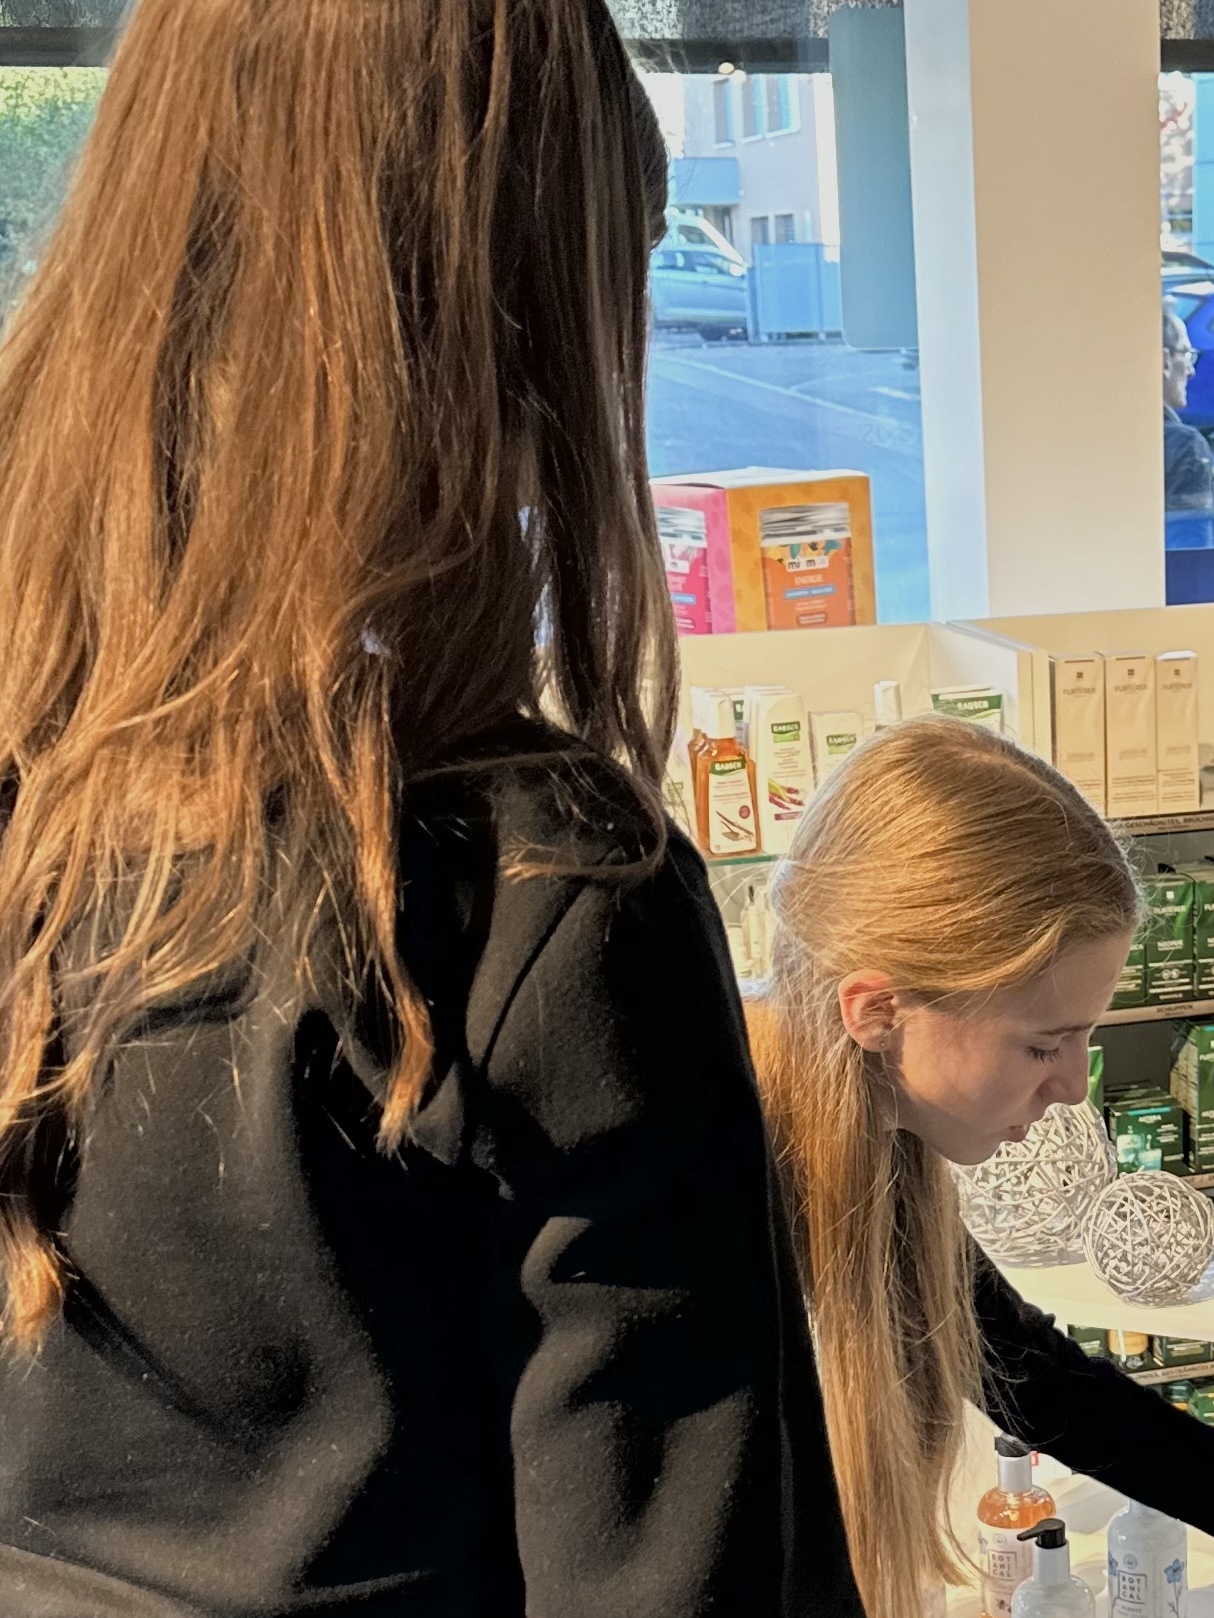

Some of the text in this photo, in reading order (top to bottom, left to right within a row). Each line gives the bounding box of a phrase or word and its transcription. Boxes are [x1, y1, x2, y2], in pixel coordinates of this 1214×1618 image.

[1121, 1575, 1142, 1585] BOT
[1122, 1584, 1141, 1593] ANI
[1121, 1590, 1142, 1601] CAL
